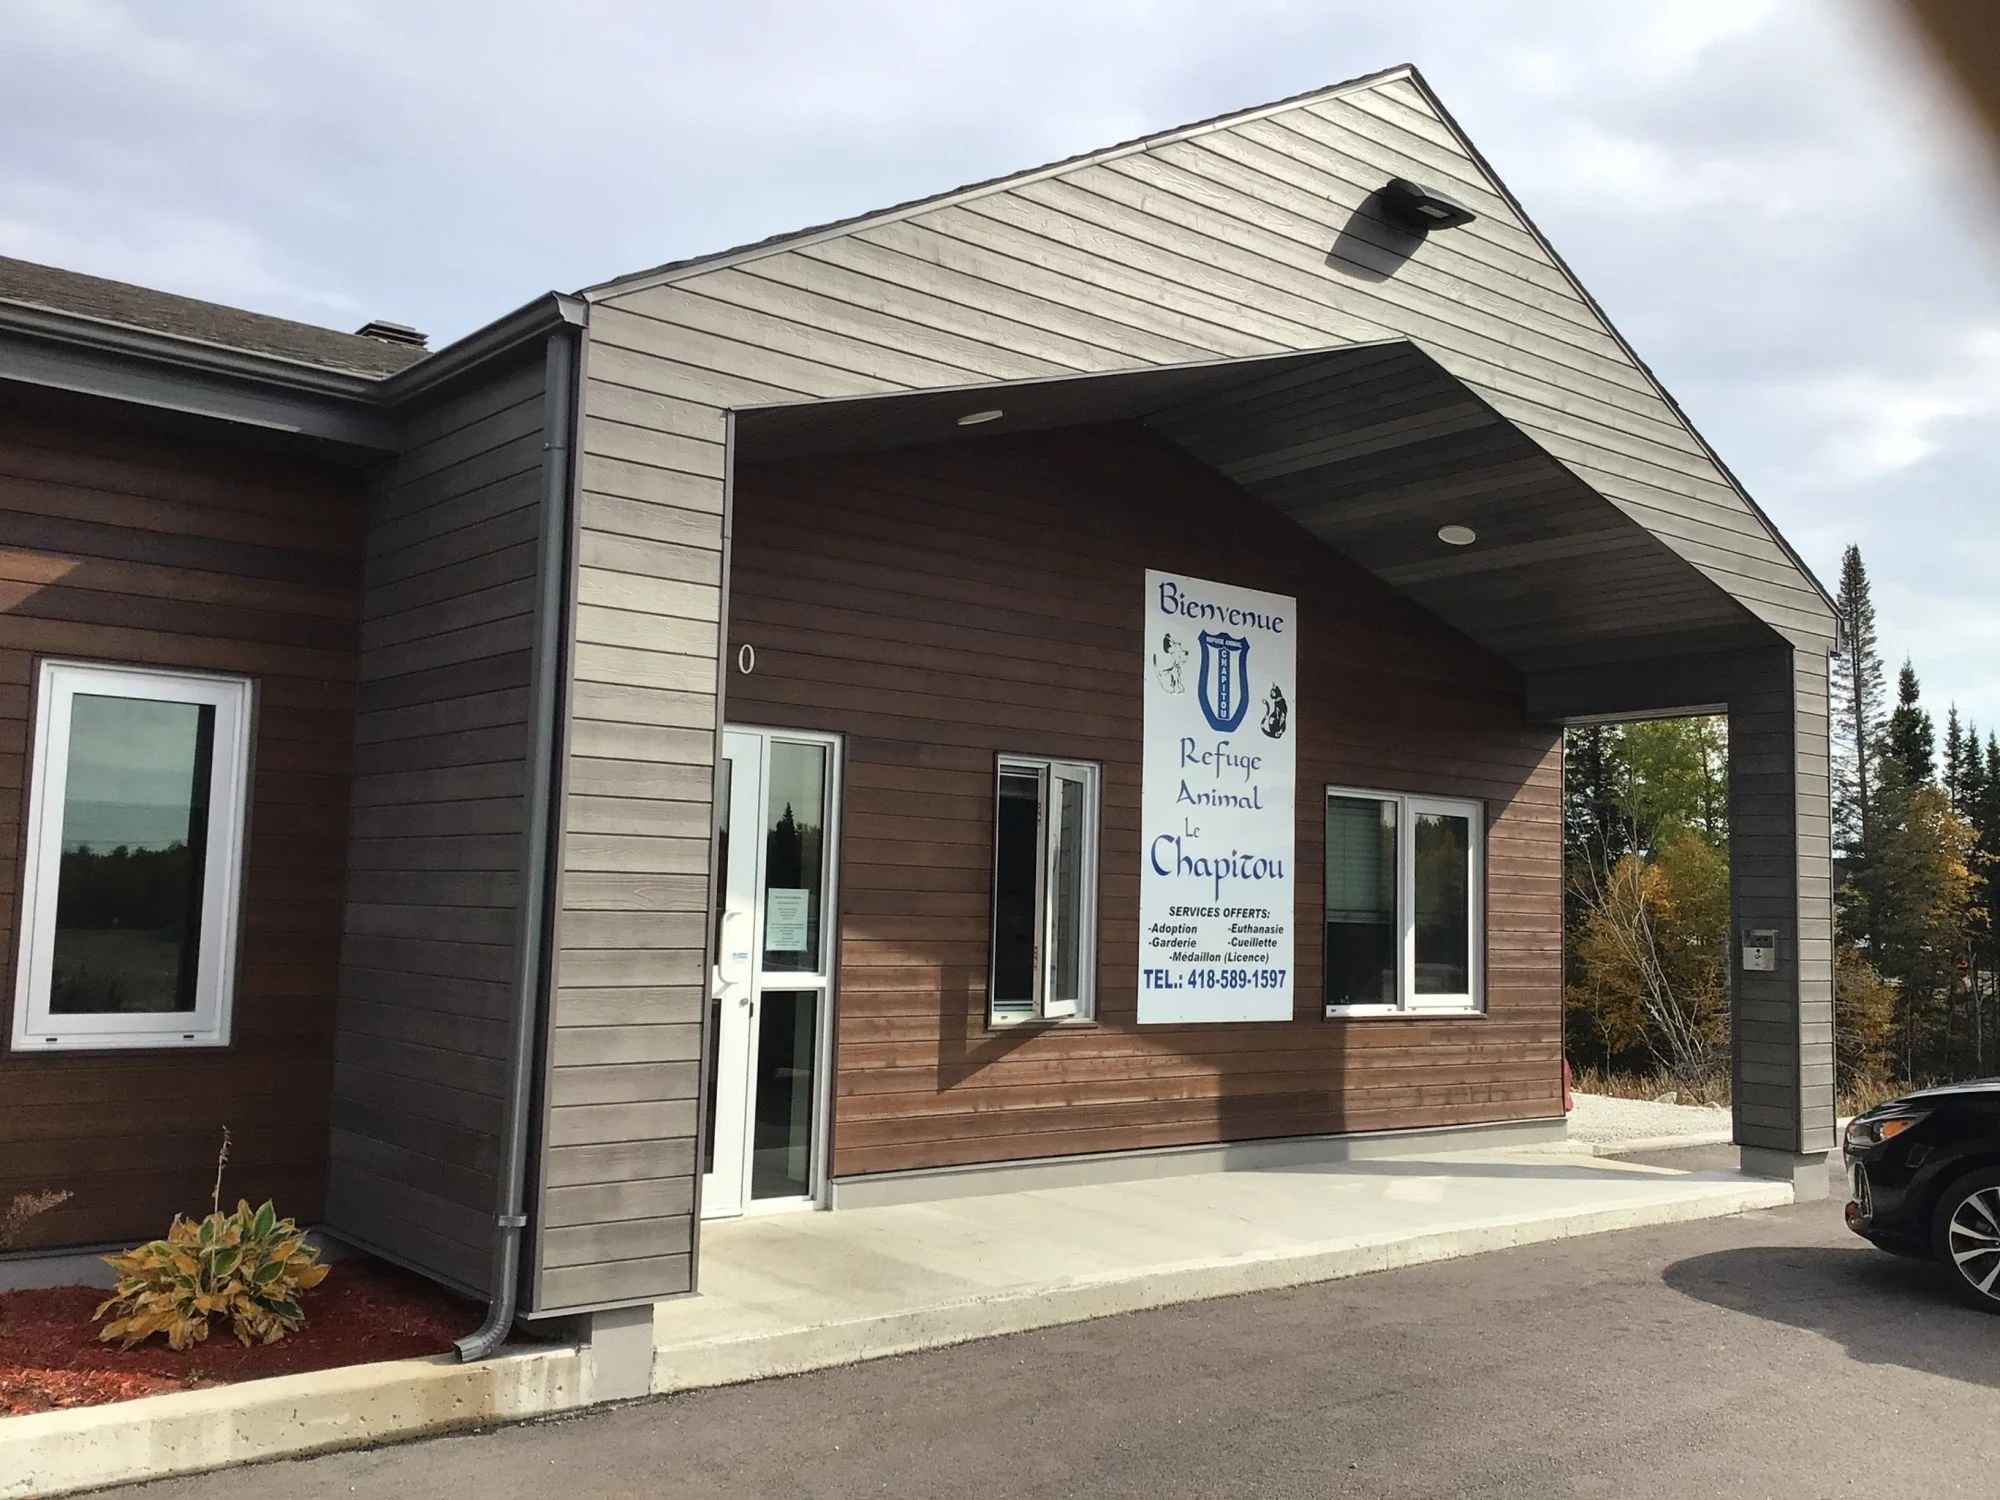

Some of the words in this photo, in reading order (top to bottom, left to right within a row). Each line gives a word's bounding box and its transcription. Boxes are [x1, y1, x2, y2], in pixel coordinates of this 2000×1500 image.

[1159, 582, 1284, 633] Bienvenue
[738, 643, 755, 674] 0
[1219, 650, 1229, 718] CHAPITOU
[1180, 737, 1262, 783] Refuge
[1176, 779, 1263, 810] Animal
[1185, 817, 1200, 838] Le
[1151, 834, 1284, 902] Chapitou
[1169, 906, 1220, 918] SERVICES
[1223, 908, 1271, 919] OFFERTS:
[1148, 923, 1198, 936] -Adoption
[1228, 923, 1284, 934] -Euthanasie
[1148, 937, 1197, 948] -Garderie
[1227, 937, 1278, 948] -Cueillette
[1169, 950, 1221, 962] -Médaillon
[1224, 952, 1269, 964] (Licence)
[1144, 969, 1183, 989] TEL.:
[1188, 969, 1286, 989] 418-589-1597
